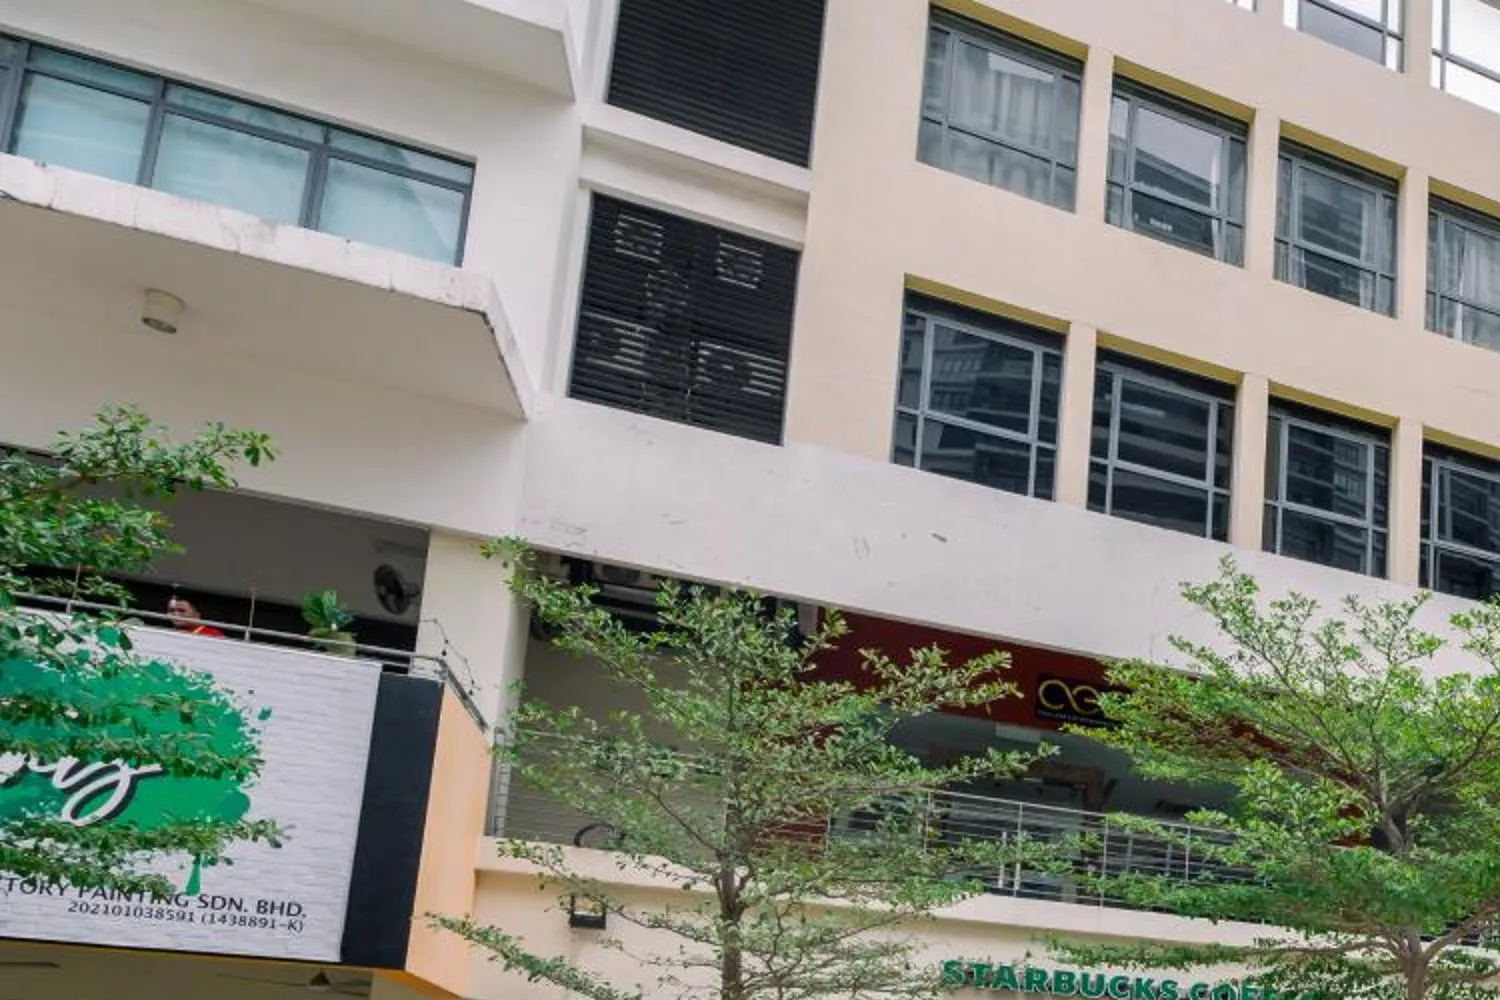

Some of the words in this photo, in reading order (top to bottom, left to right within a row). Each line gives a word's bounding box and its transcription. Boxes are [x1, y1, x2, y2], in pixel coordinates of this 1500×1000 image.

[0, 874, 70, 897] TORY
[196, 893, 249, 913] SDN.
[256, 899, 308, 919] BHD.
